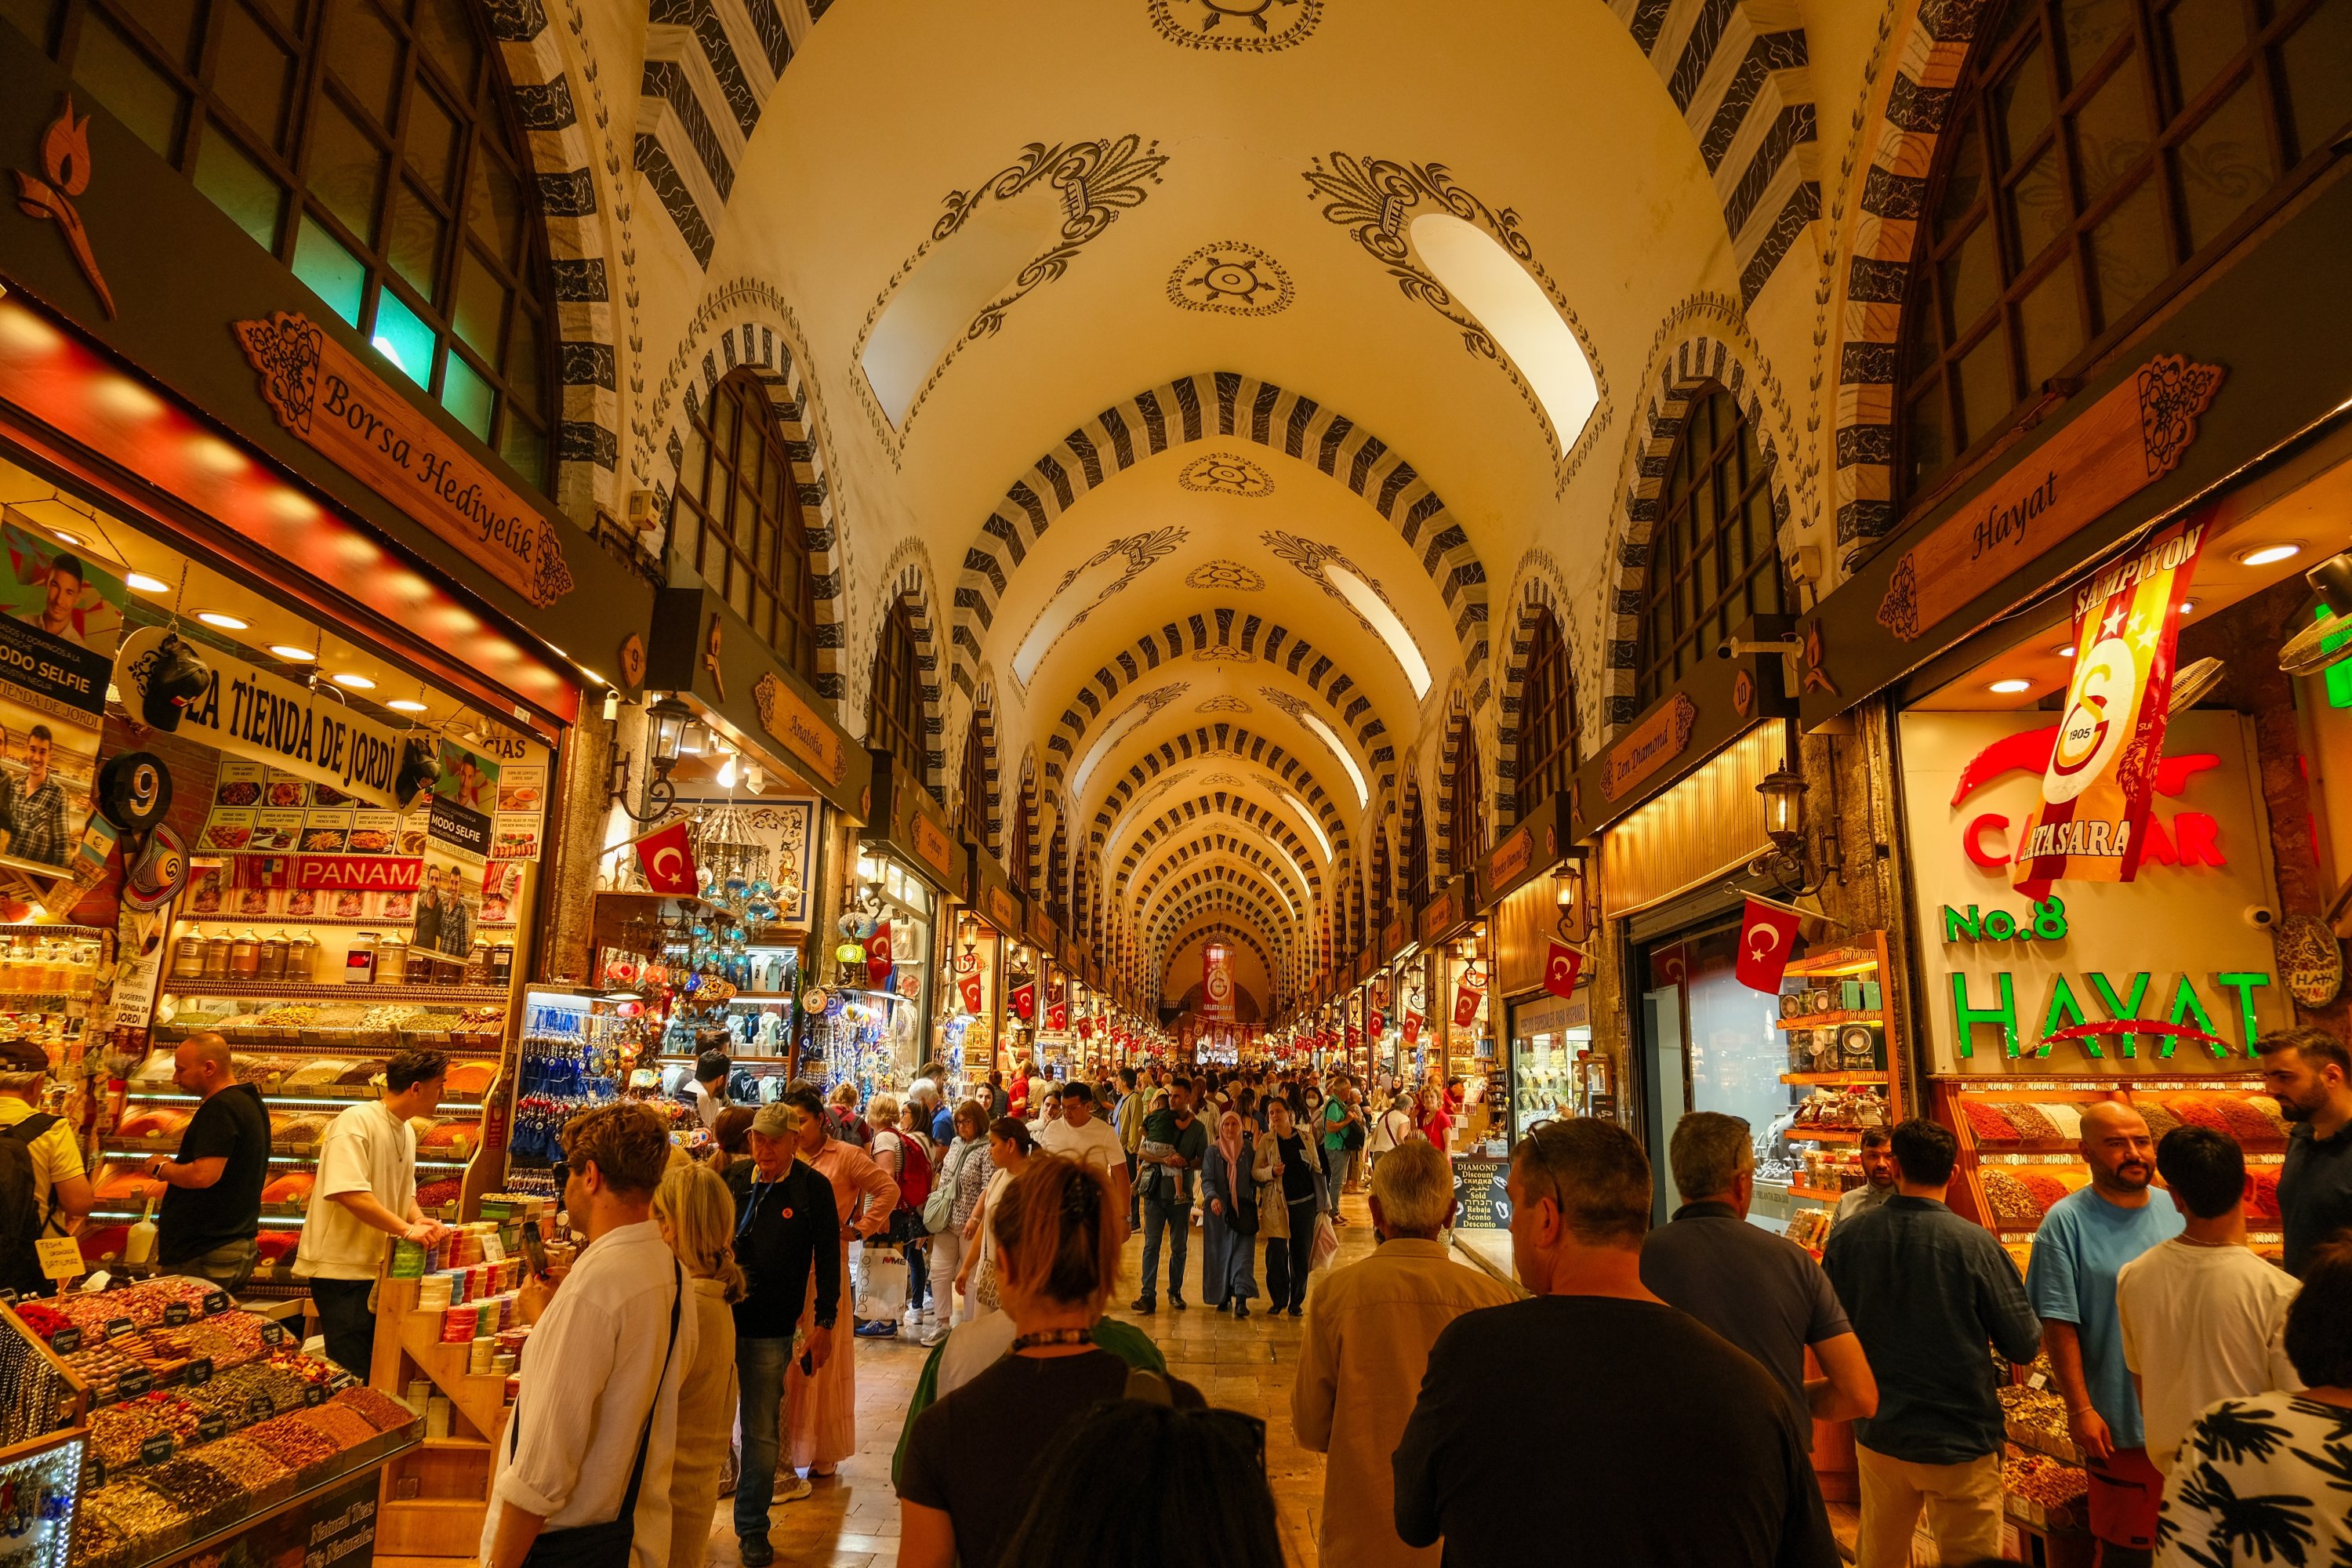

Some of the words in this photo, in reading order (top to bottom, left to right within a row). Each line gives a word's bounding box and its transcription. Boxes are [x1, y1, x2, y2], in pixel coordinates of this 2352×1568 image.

[323, 375, 410, 469] Borsa
[417, 452, 534, 563] Hediyelik
[1972, 470, 2058, 561] Hayat
[2075, 523, 2205, 624] ŞAMPİYON
[0, 644, 35, 671] ODO
[38, 662, 91, 695] SELFIE
[631, 648, 639, 671] 9
[44, 698, 60, 714] DE
[63, 706, 99, 728] JORDI
[1737, 682, 1748, 706] 10
[317, 716, 346, 775] DE
[789, 714, 824, 758] Anatolia
[1617, 762, 1630, 782] Zen
[1632, 718, 1670, 770] Diamond
[2069, 728, 2092, 742] 1905
[129, 764, 159, 817] 9
[430, 814, 455, 832] MODO
[455, 824, 481, 843] SELFIE
[428, 837, 435, 845] LA
[436, 839, 456, 855] TIENDA
[457, 848, 465, 858] DE
[466, 851, 485, 865] JORDI
[1944, 895, 2069, 942] No.8
[120, 978, 148, 990] ESTAMBUL
[116, 1012, 141, 1025] JORDI
[141, 1005, 149, 1014] DE
[1534, 1011, 1555, 1032] ESPECIALES
[1555, 1008, 1566, 1027] PARA
[1566, 1003, 1586, 1024] HISPANOS
[1950, 971, 2271, 1059] HAYAT
[1467, 1206, 1491, 1215] Rebaja
[856, 1255, 871, 1313] DeFacto
[310, 1505, 352, 1547] Natural
[351, 1500, 376, 1524] Teas
[325, 1524, 375, 1566] Naturales
